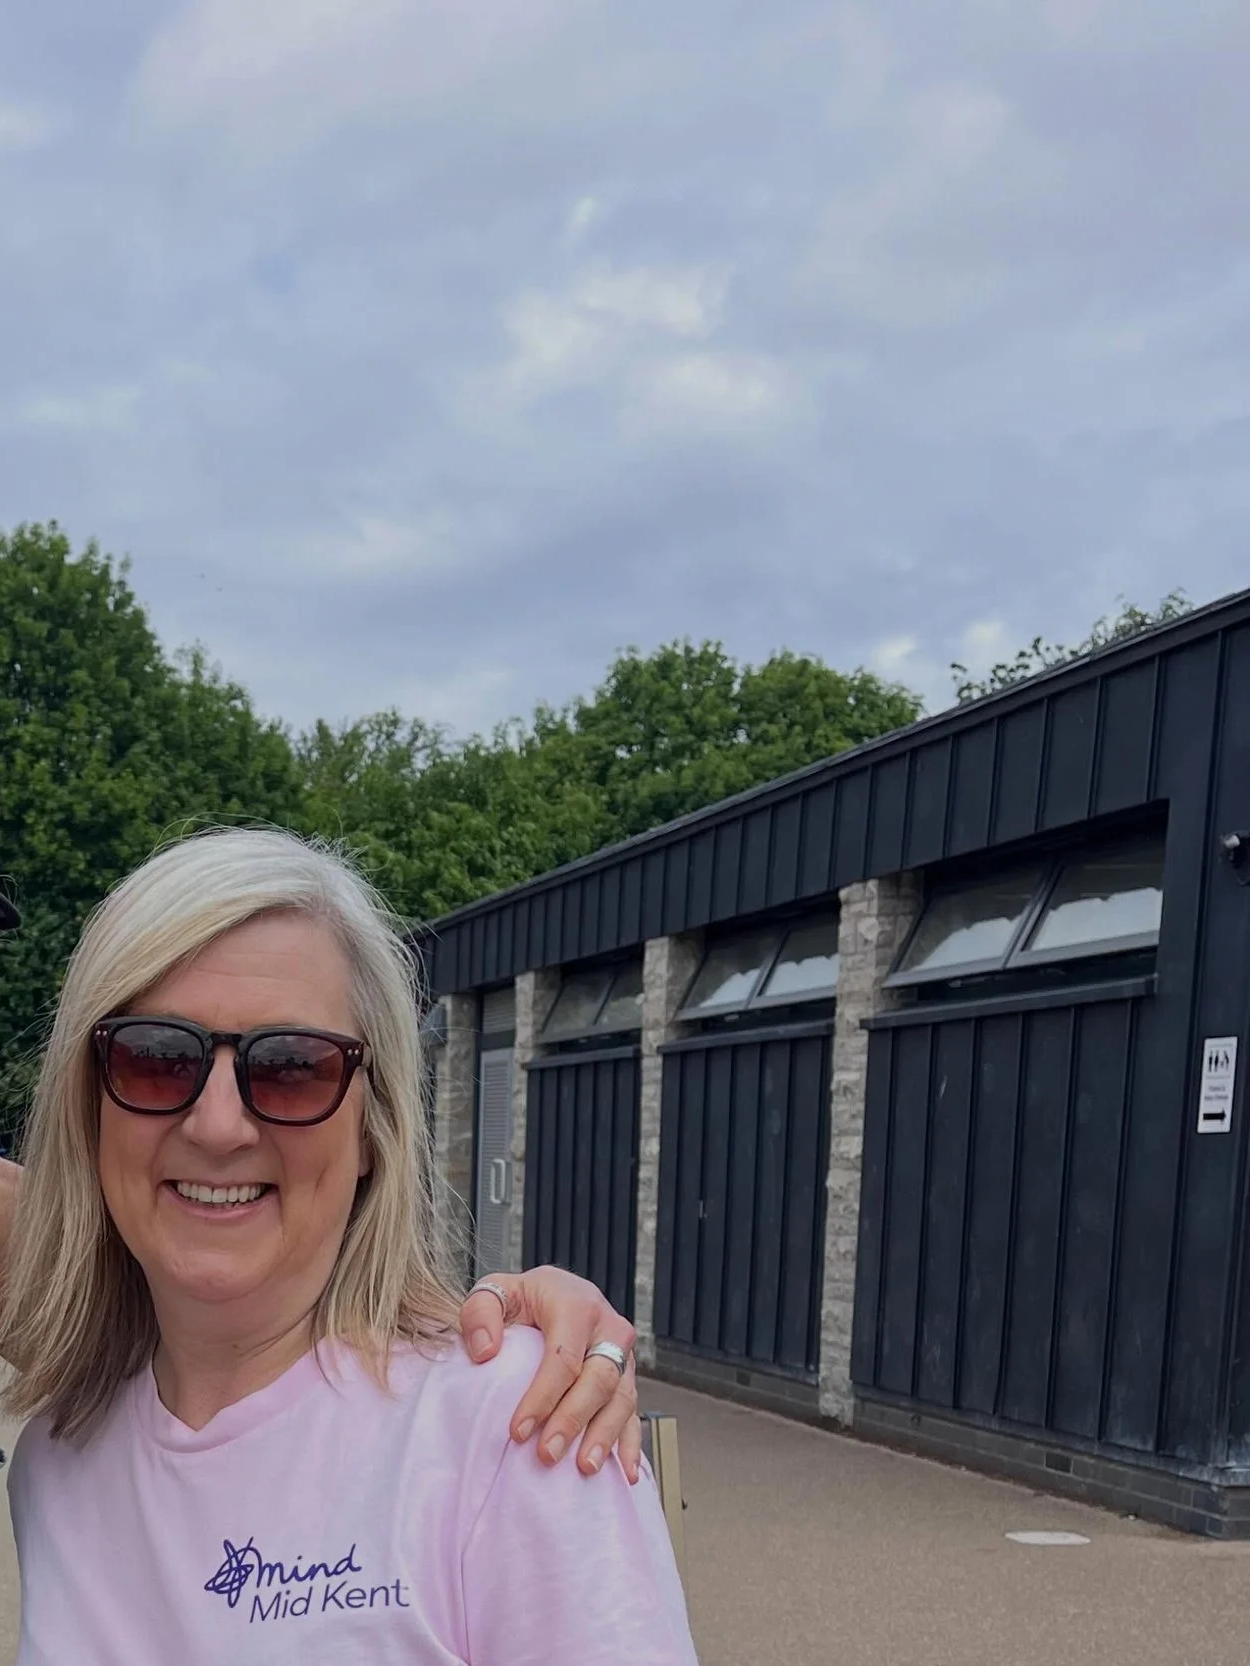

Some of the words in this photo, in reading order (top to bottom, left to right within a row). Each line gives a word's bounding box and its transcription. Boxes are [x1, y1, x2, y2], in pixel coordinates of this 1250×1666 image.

[255, 1543, 362, 1589] mind
[249, 1586, 313, 1623] Mid
[321, 1578, 410, 1612] Kent
